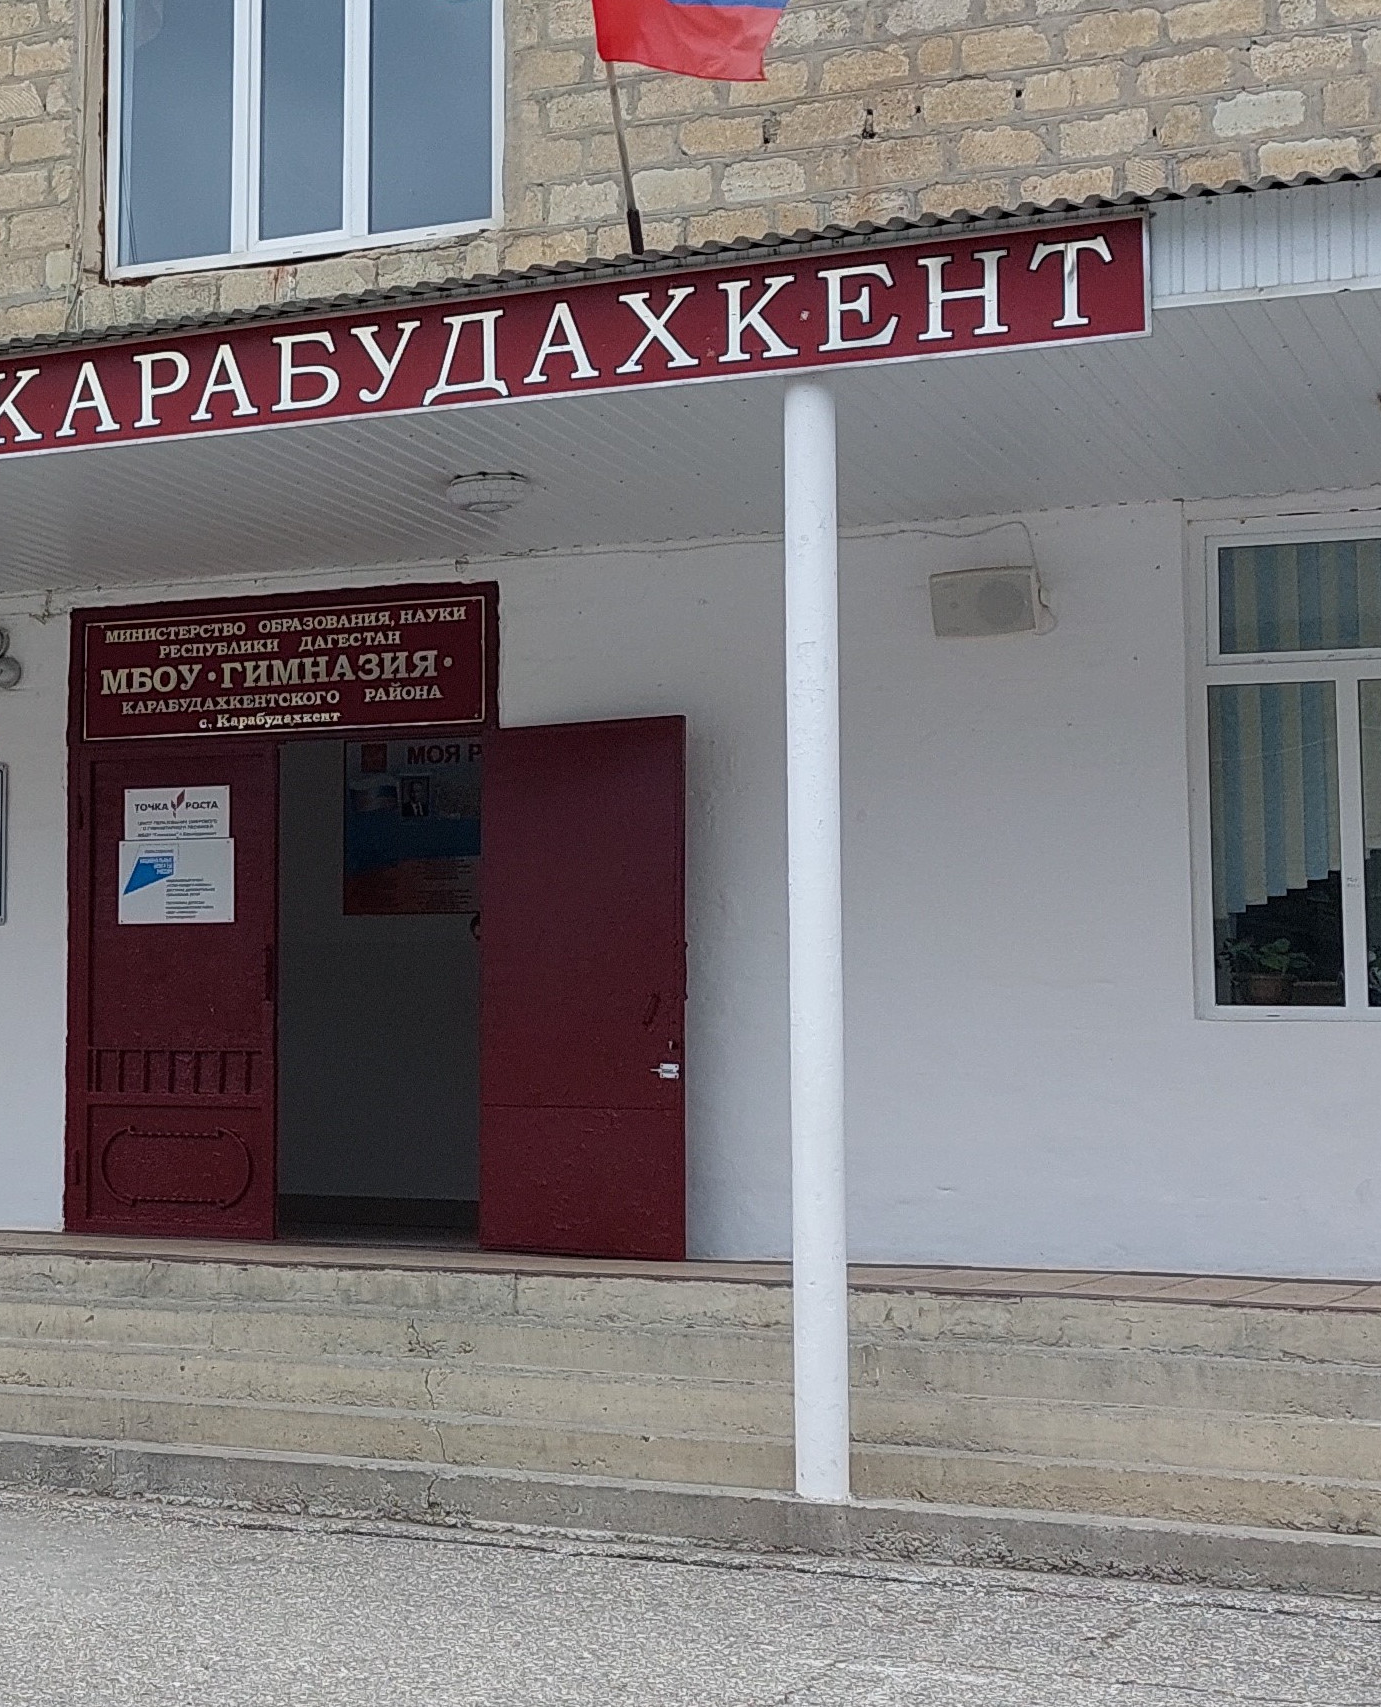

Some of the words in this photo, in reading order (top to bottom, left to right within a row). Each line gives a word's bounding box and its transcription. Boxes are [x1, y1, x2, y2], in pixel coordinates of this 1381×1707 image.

[104, 621, 246, 643] МИНИСТЕРСТВО
[258, 611, 395, 633] ОБРАЗОВАНИЯ,
[399, 606, 467, 624] НАУКИ
[159, 638, 280, 658] РЕСПУБЛИКИ
[298, 631, 402, 653] ДАГЕСТАН
[100, 663, 203, 695] МБОУ
[121, 690, 340, 715] КАРАБУДАХКЕНТСКОГО
[364, 682, 444, 703] РАЙОНА
[216, 712, 342, 729] Карабудахкент
[407, 743, 461, 765] МОЯ
[134, 802, 169, 812] ТОЧКА
[185, 800, 219, 810] РОСТА
